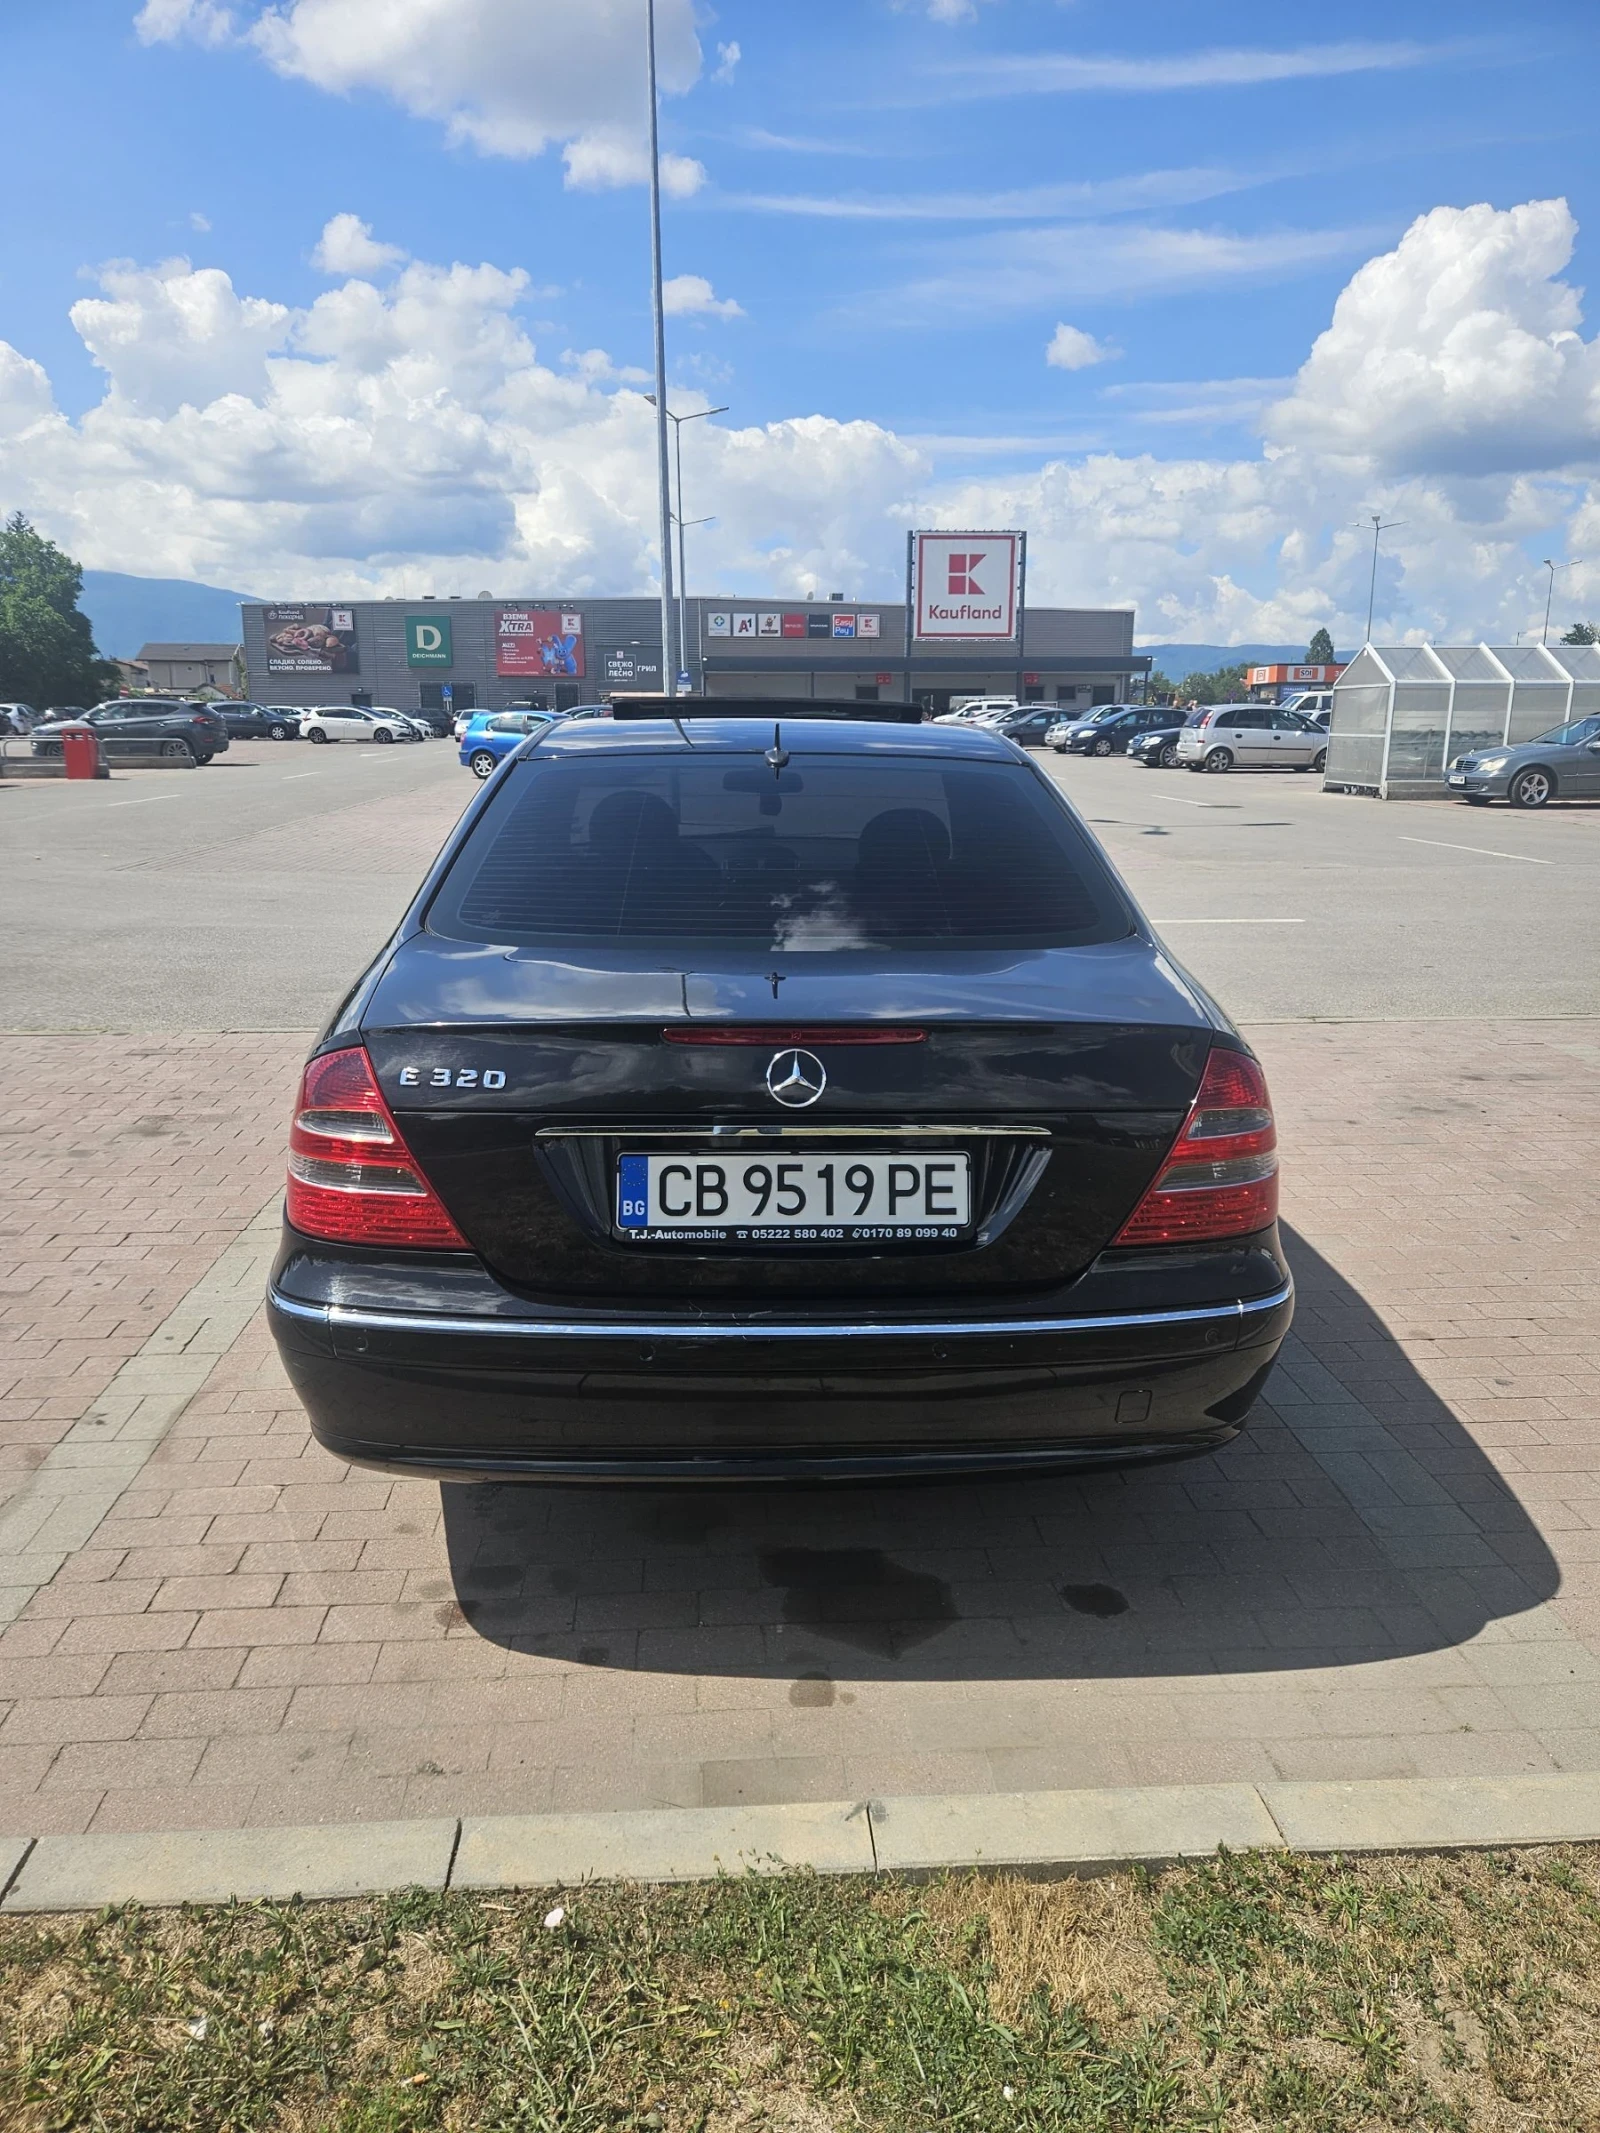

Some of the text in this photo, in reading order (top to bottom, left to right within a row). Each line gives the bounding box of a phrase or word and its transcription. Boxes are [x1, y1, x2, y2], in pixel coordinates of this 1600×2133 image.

[929, 605, 1002, 619] Kaufland
[738, 618, 752, 633] A1
[835, 619, 853, 627] Easy
[416, 625, 442, 651] D
[835, 627, 850, 635] Pay
[400, 1066, 506, 1089] E 320
[659, 1163, 957, 1217] CB 9519 PE
[623, 1201, 645, 1216] BG
[629, 1228, 957, 1240] T.J.-Automobile 05222 580 402 0170 89 099 40
